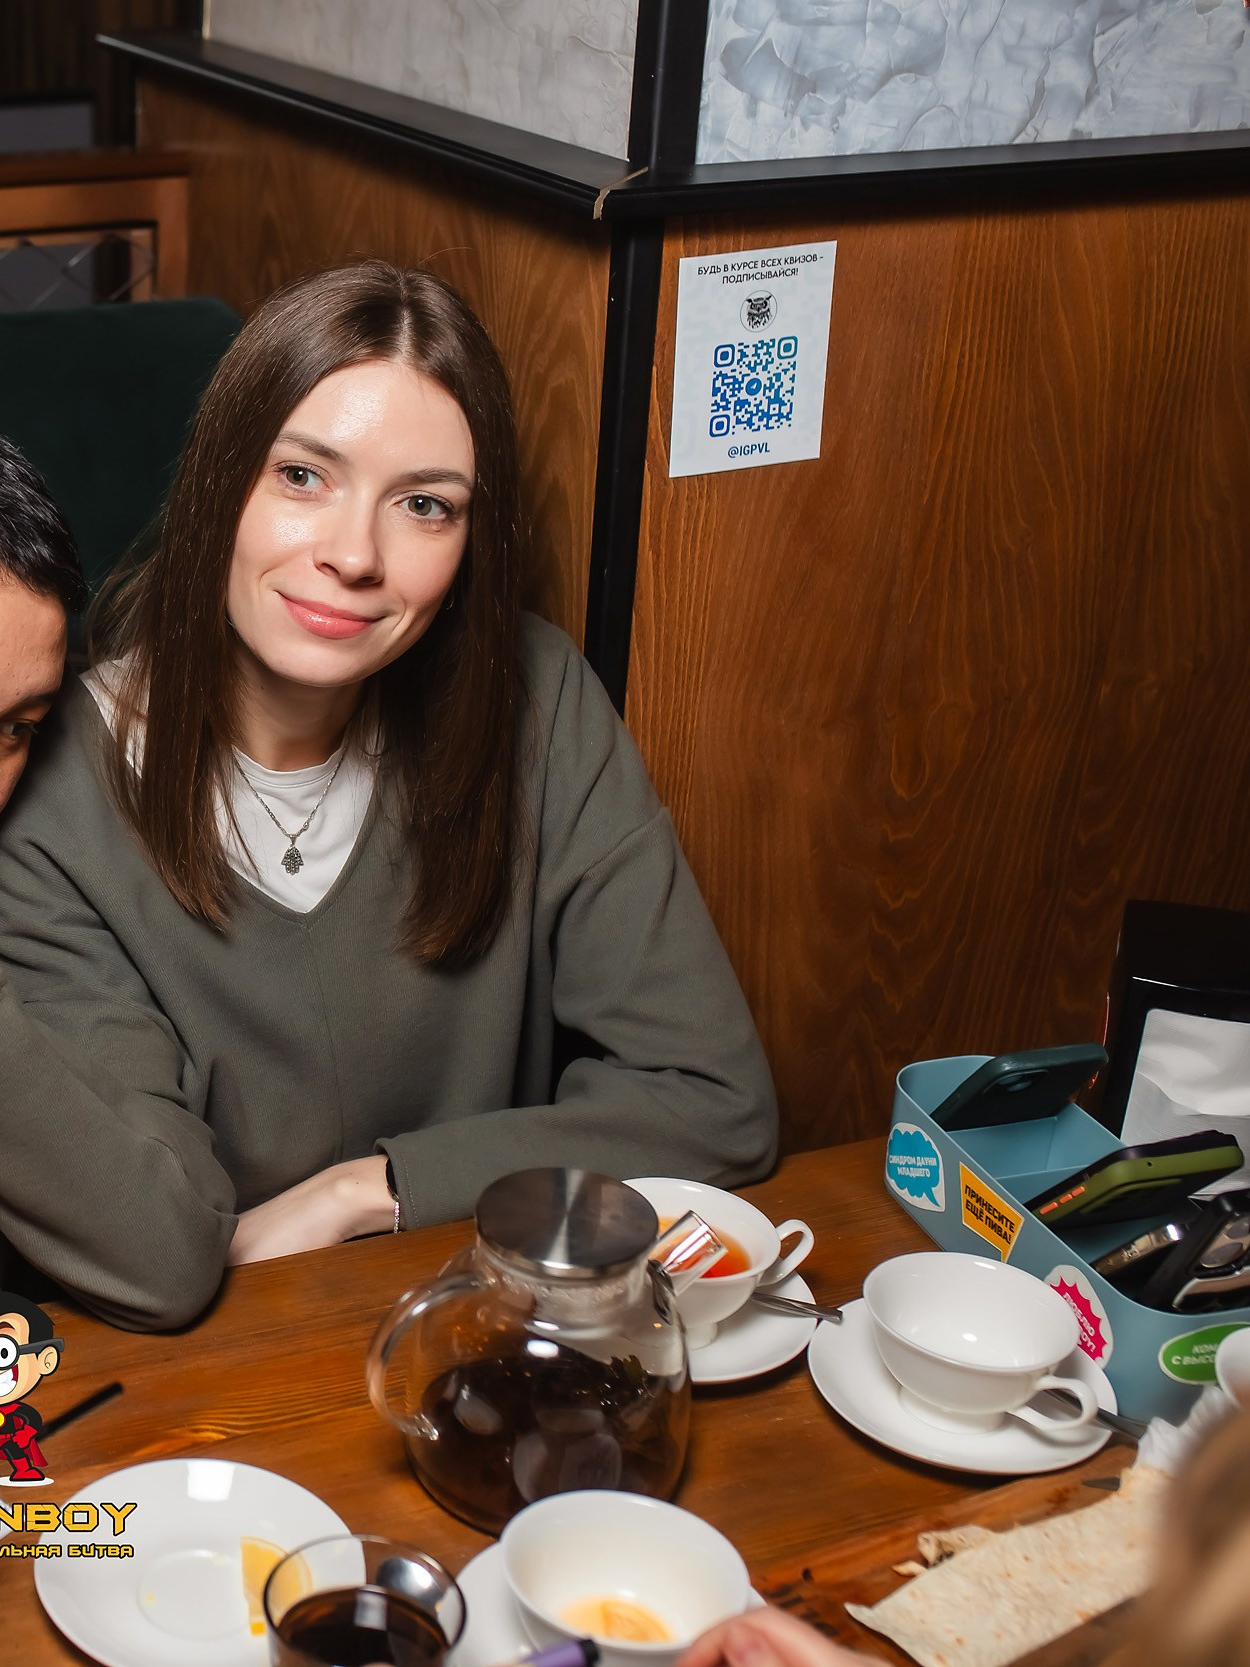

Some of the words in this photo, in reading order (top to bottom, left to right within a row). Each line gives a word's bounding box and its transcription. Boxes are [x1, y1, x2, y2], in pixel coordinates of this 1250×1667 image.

[697, 265, 722, 275] БУДЬ
[723, 264, 729, 273] В
[731, 260, 759, 272] КУРСЕ
[760, 258, 782, 268] ВСЕХ
[784, 254, 818, 266] КВИЗОВ
[722, 268, 799, 284] ПОДПИСЫВАЙСЯ!
[727, 442, 771, 459] @IGPVL
[964, 1184, 1015, 1233] ПРИНЕСИТЕ
[965, 1200, 984, 1222] ЕЩЁ
[985, 1218, 1012, 1245] ПИВА!
